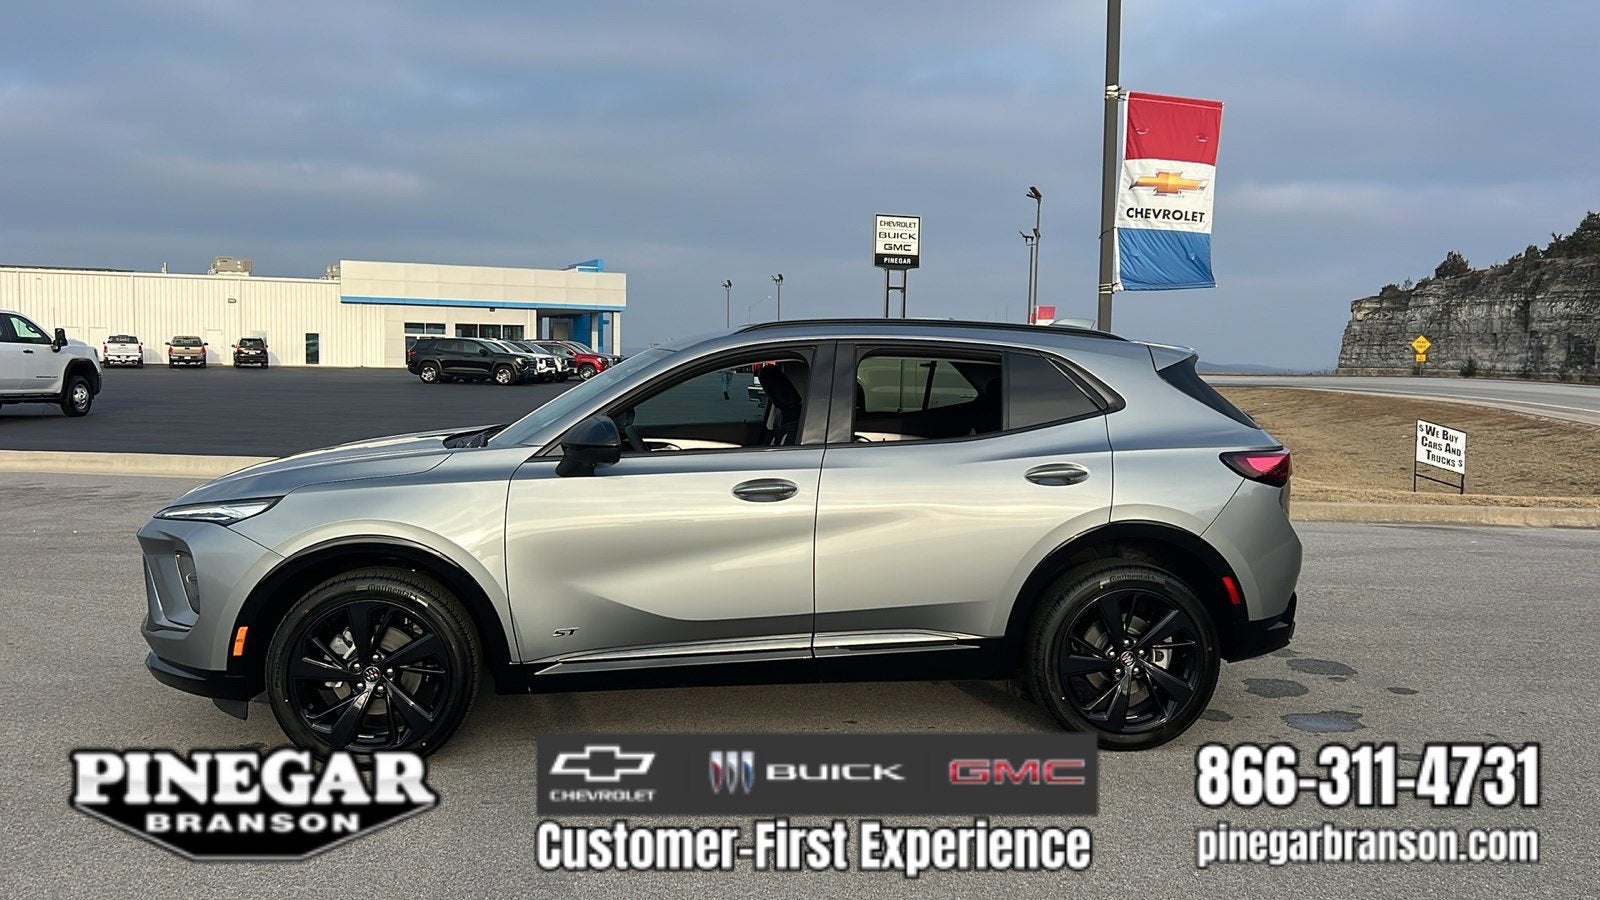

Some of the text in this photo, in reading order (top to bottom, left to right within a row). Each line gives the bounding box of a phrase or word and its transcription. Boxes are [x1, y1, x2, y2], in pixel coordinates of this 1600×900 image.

[1126, 207, 1205, 222] CHEVROLET
[879, 220, 916, 228] CHEVROLET
[879, 232, 916, 240] BUICK
[884, 243, 911, 251] GMC
[1425, 424, 1440, 439] WE
[1442, 429, 1459, 444] BUY
[1421, 435, 1462, 457] CARS AND
[1426, 449, 1455, 467] TRUCKS
[552, 627, 580, 638] ST
